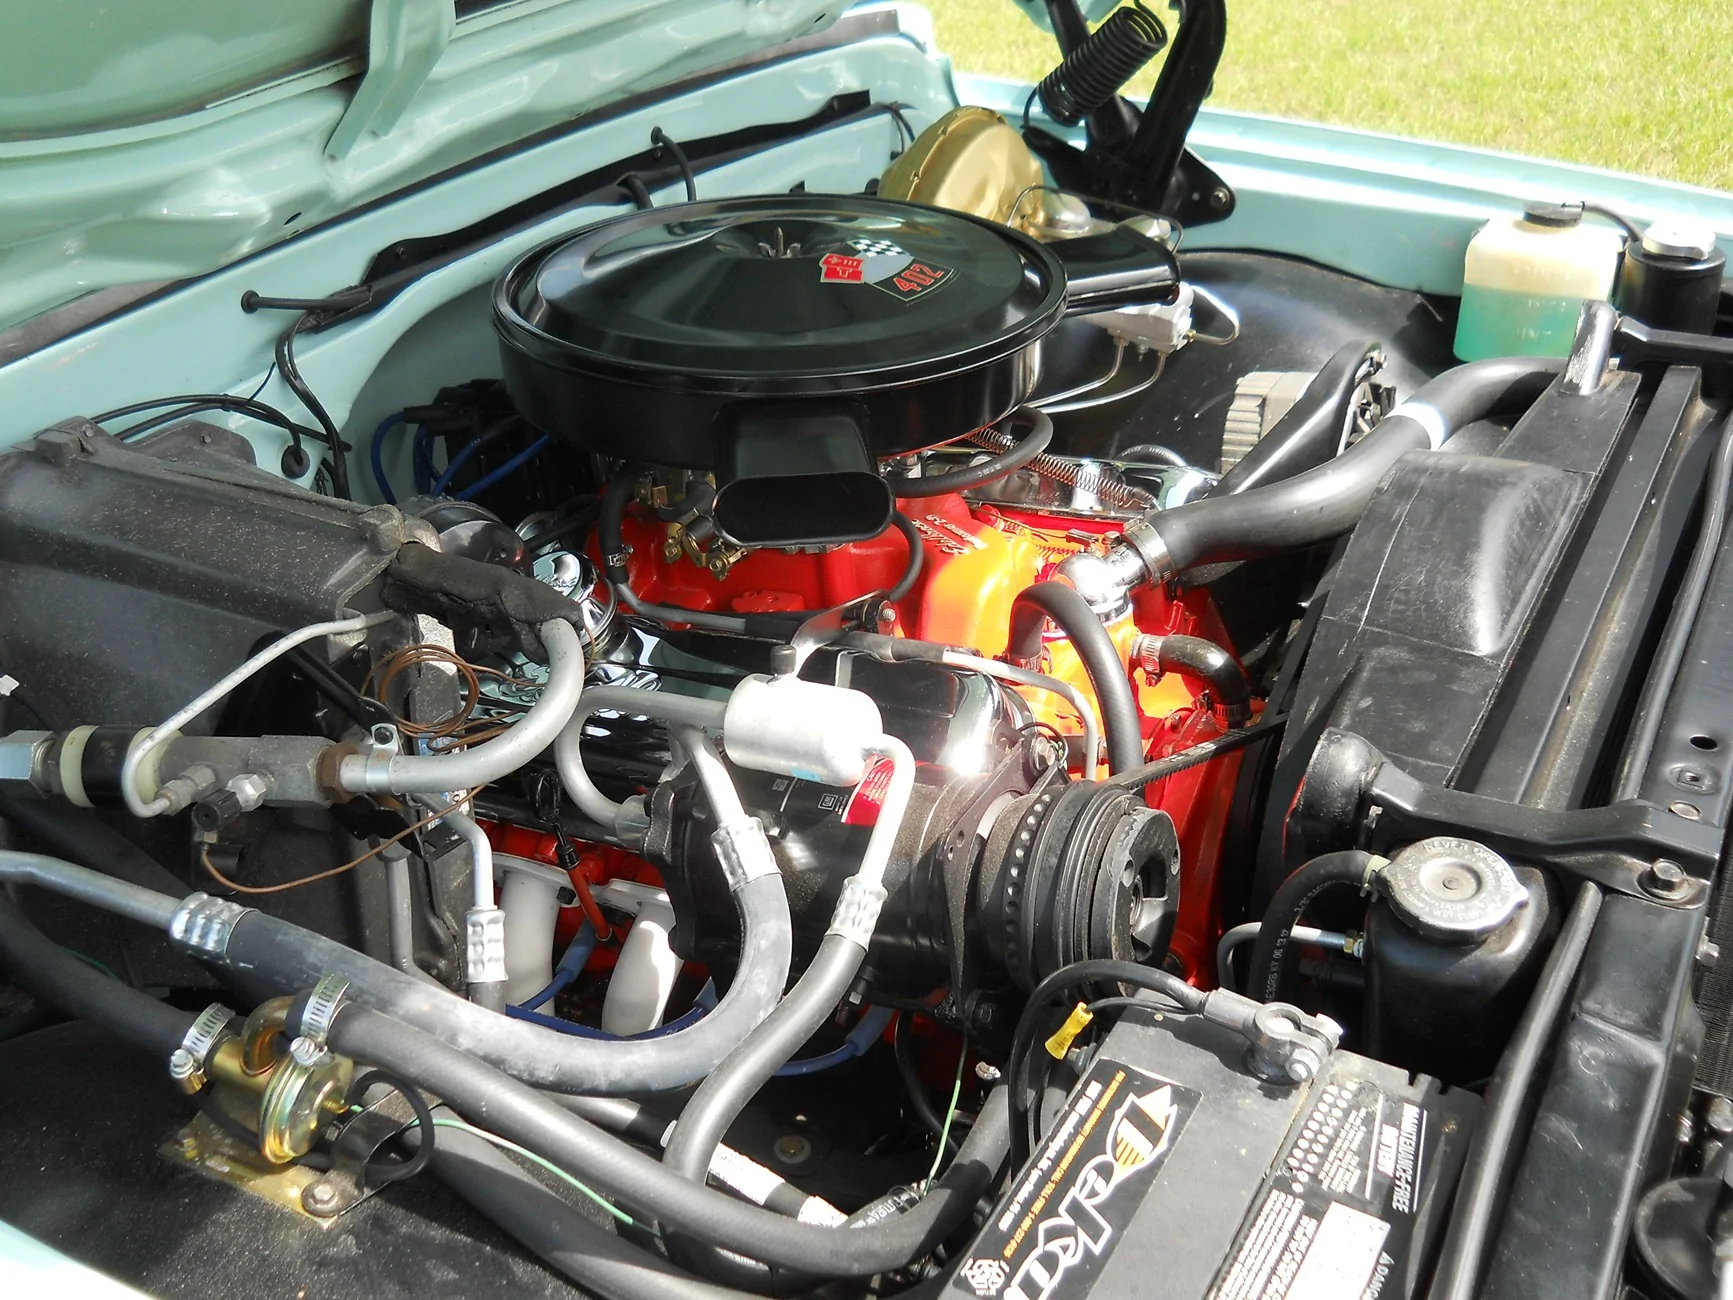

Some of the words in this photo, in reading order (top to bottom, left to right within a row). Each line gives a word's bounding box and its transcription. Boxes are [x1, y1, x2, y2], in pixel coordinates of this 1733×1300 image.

[893, 263, 944, 292] 402
[1423, 841, 1468, 851] NEVER
[1377, 1124, 1398, 1176] BATTERY
[1392, 1103, 1419, 1213] MAINTENANCE-FREE
[1003, 1084, 1177, 1300] Deka
